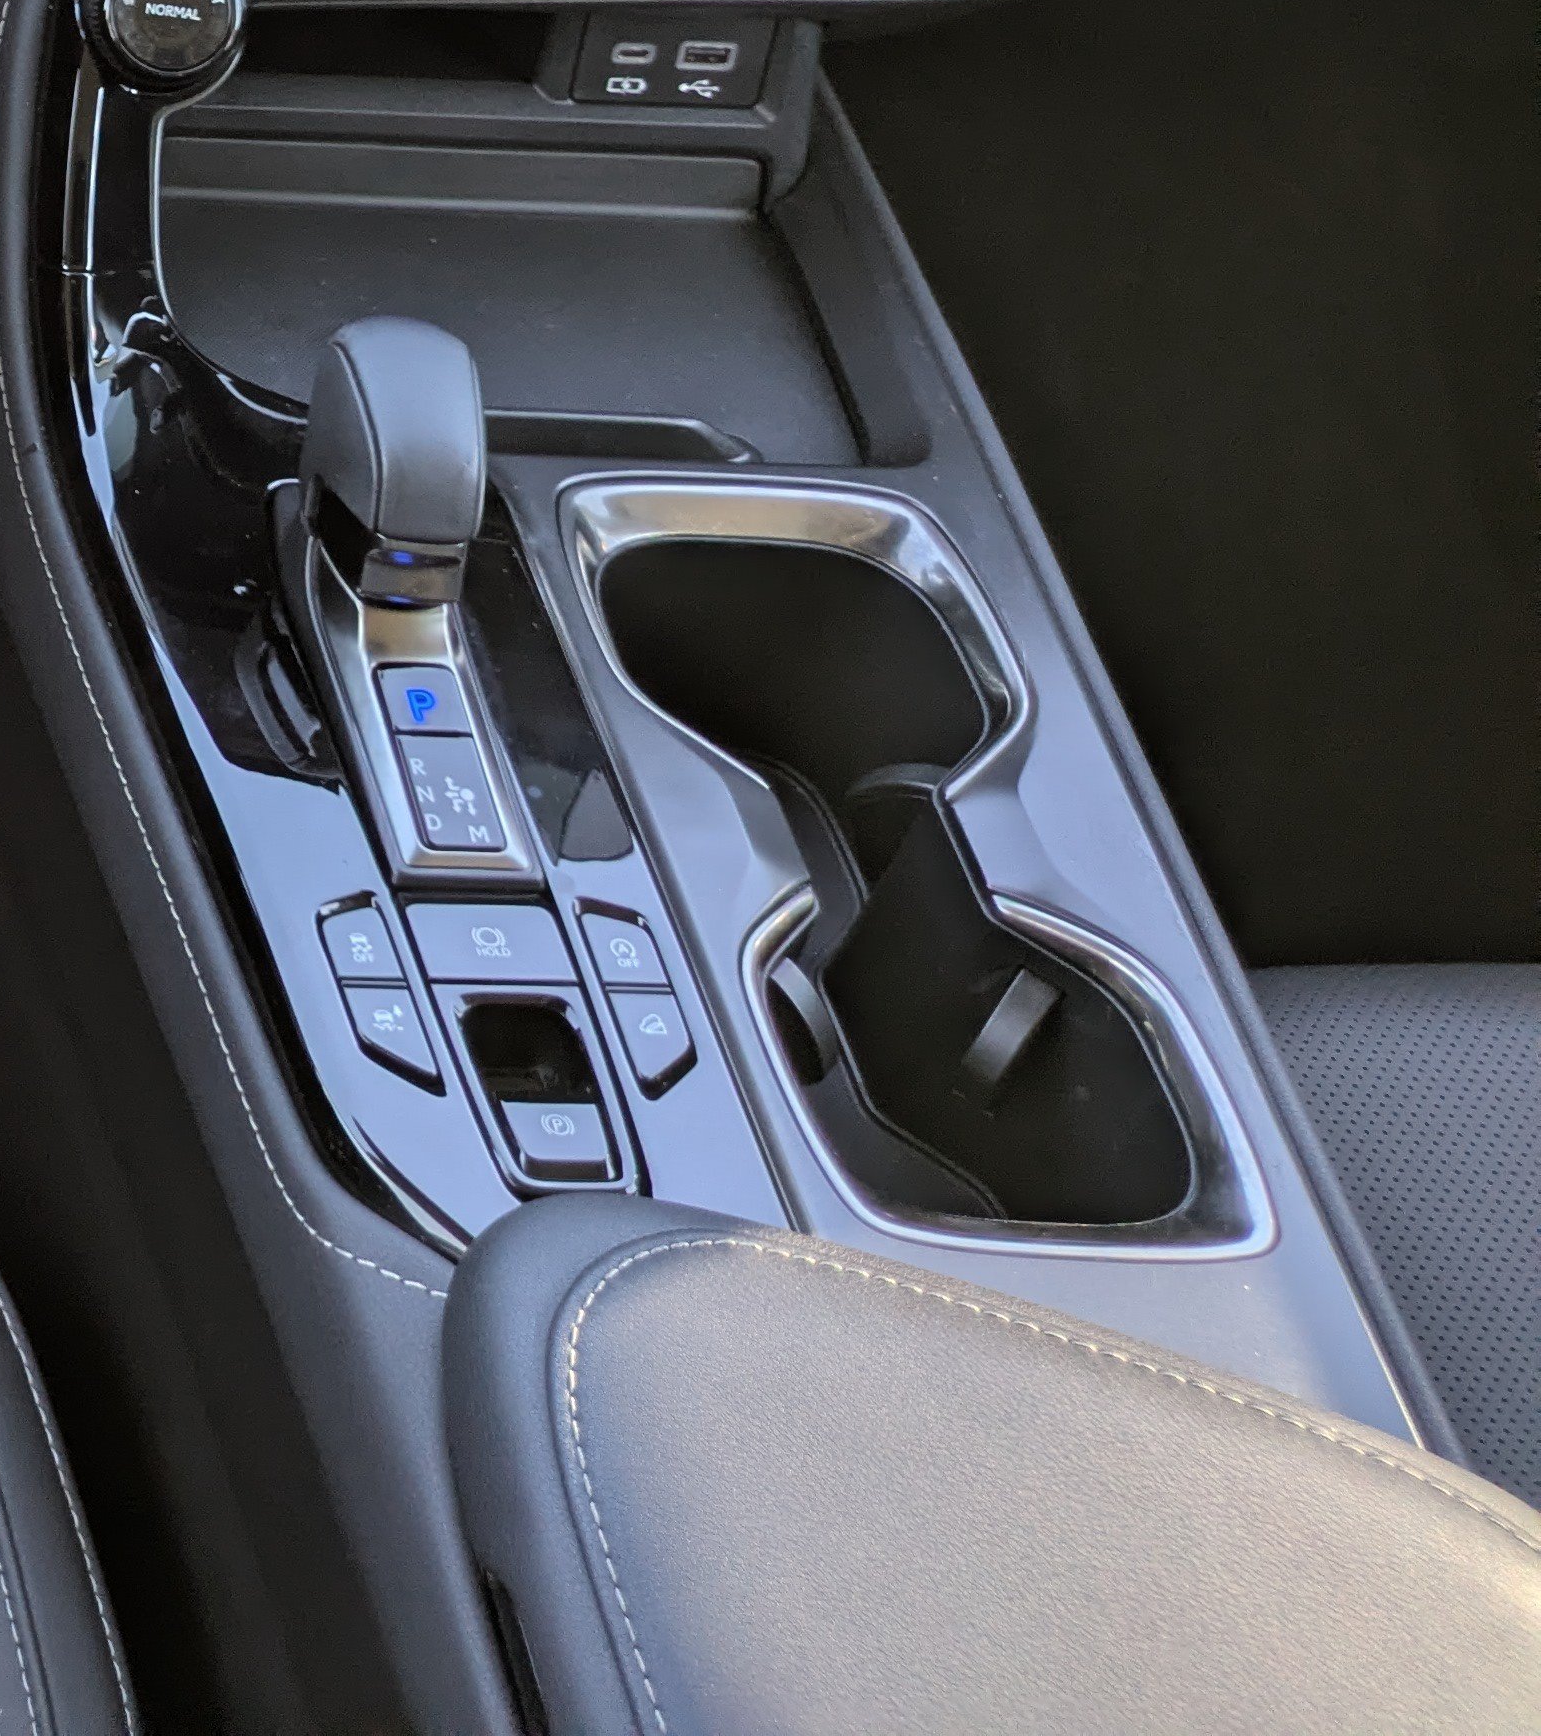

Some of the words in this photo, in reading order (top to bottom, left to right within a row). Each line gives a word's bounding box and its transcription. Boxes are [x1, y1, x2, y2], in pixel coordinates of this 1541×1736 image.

[144, 2, 202, 22] NORMAL
[405, 688, 437, 724] P
[408, 757, 427, 776] R
[417, 785, 436, 804] N
[467, 824, 490, 845] M
